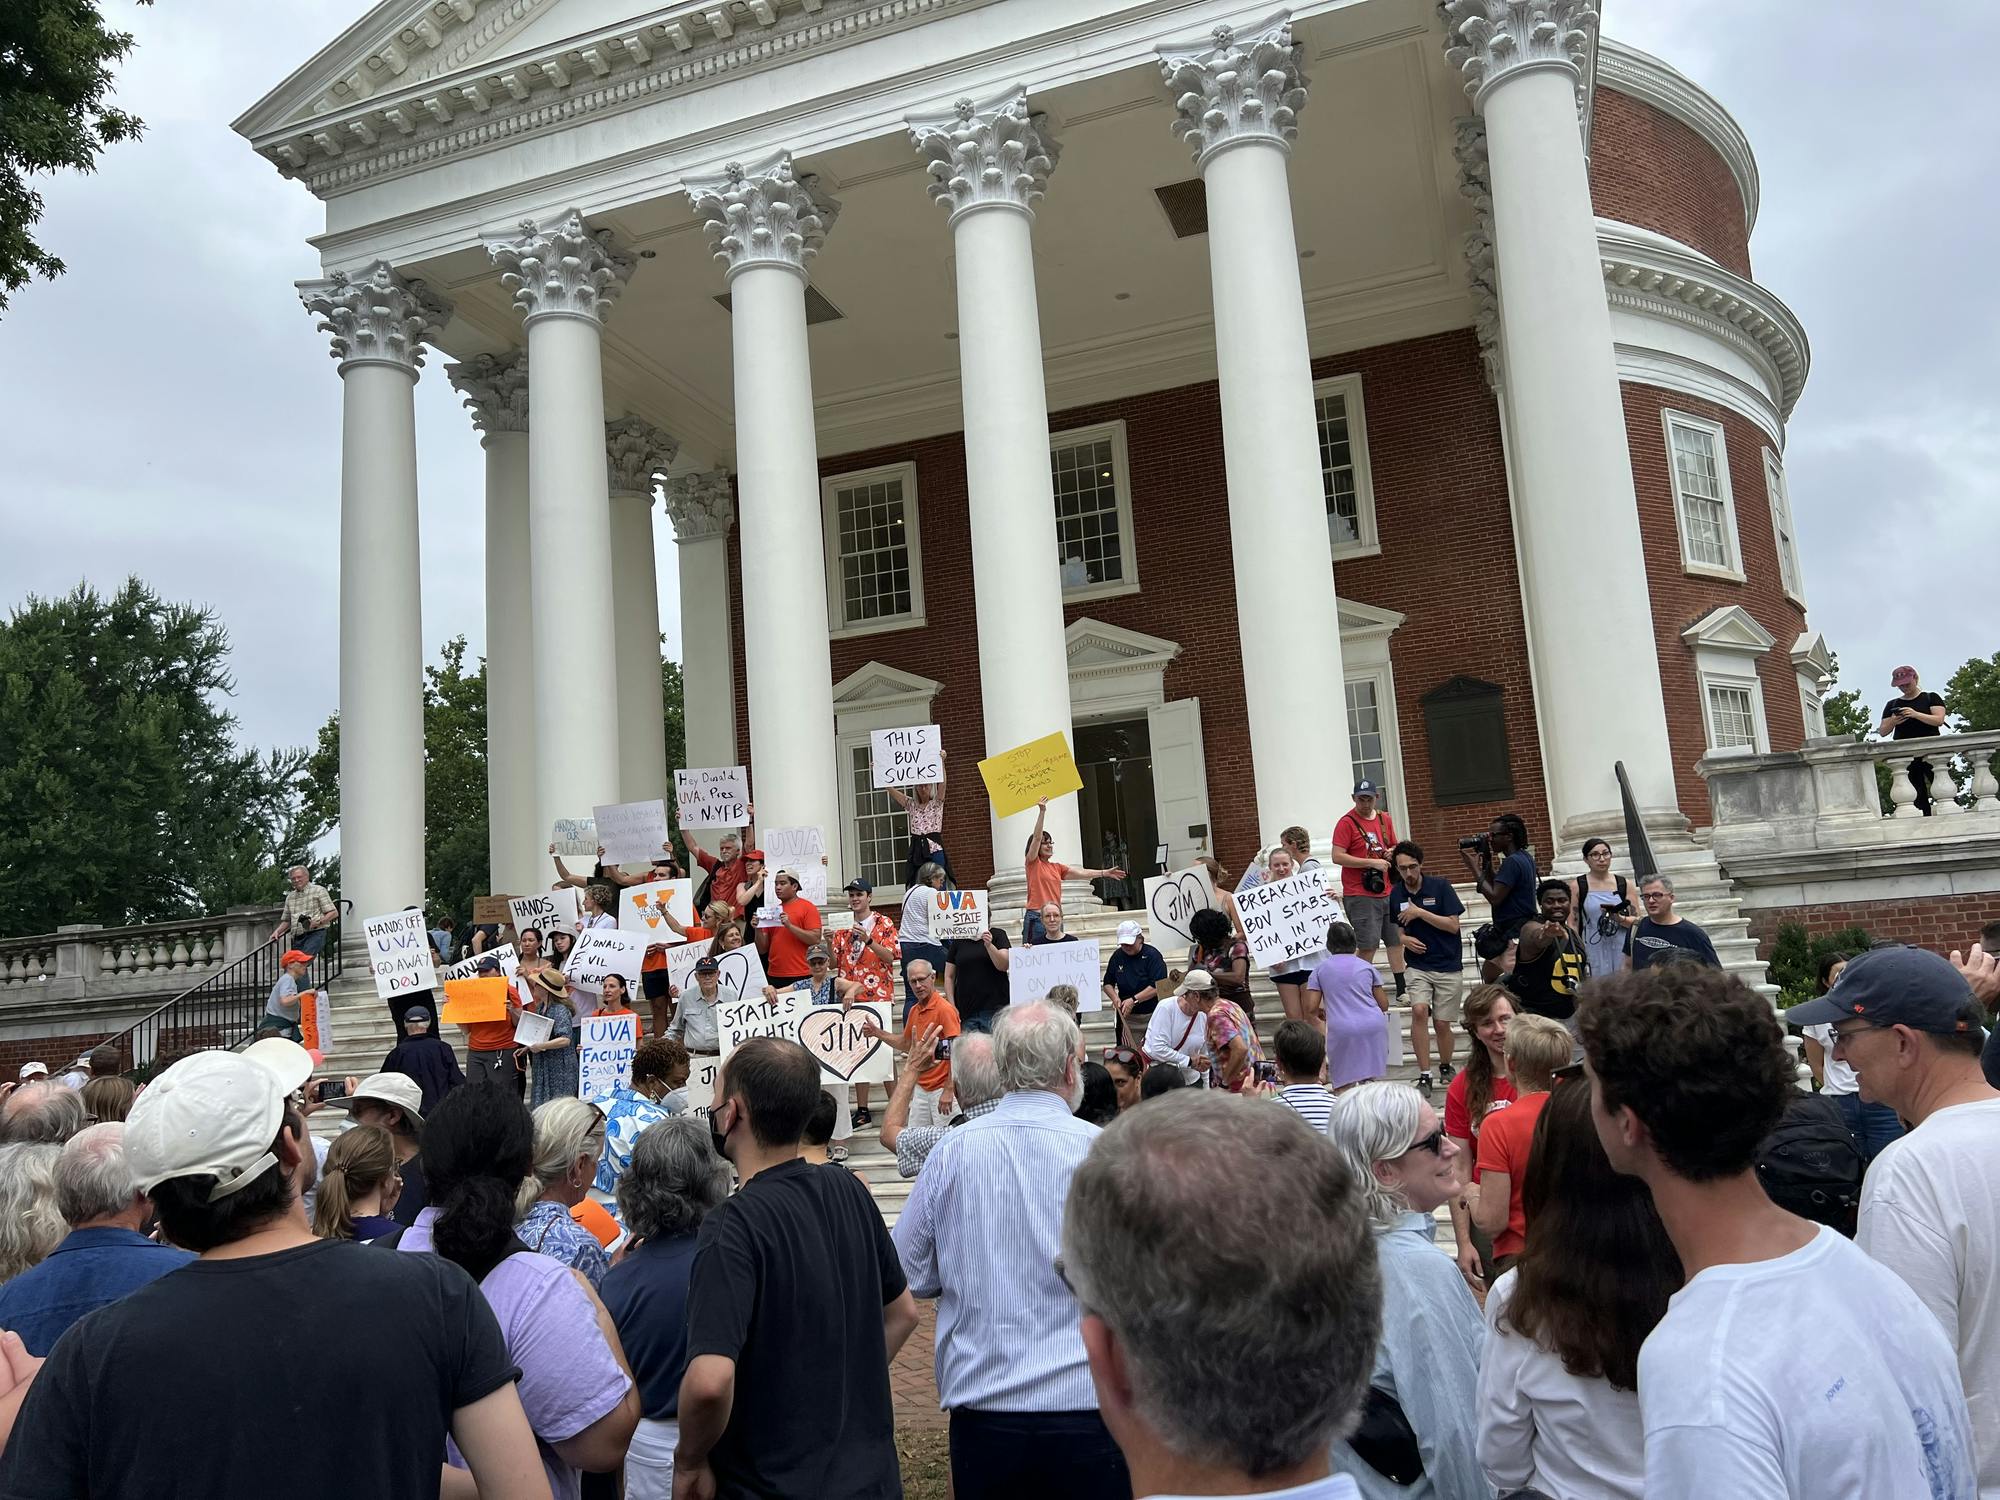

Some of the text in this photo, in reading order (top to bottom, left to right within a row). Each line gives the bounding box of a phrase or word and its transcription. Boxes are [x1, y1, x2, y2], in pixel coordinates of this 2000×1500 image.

[884, 729, 926, 747] THIS
[895, 748, 921, 765] BOV
[1007, 748, 1031, 762] STOP
[679, 773, 698, 790] Hey
[885, 764, 937, 783] SUCKS
[554, 818, 576, 832] HANDS
[768, 828, 824, 857] UVA
[937, 891, 977, 910] UVA
[1237, 873, 1327, 912] BREAKING:
[513, 896, 554, 916] HANDS
[1169, 890, 1197, 921] JIM
[1244, 894, 1330, 934] BOV STABS
[368, 915, 421, 937] HANDS OFF
[532, 914, 560, 929] OFF
[953, 912, 981, 923] STATE
[378, 932, 420, 952] UVA
[580, 934, 625, 951] DONALD
[1254, 932, 1283, 952] JIM
[1291, 921, 1306, 937] IN
[671, 945, 701, 963] WAIT
[1015, 946, 1098, 968] DON'T TREAD
[1285, 936, 1323, 959] BACK
[377, 953, 429, 975] GO AWAY
[571, 951, 607, 967] EVIL
[1028, 972, 1089, 992] ON UVA
[590, 1020, 632, 1041] UVA
[820, 1022, 869, 1052] JIM
